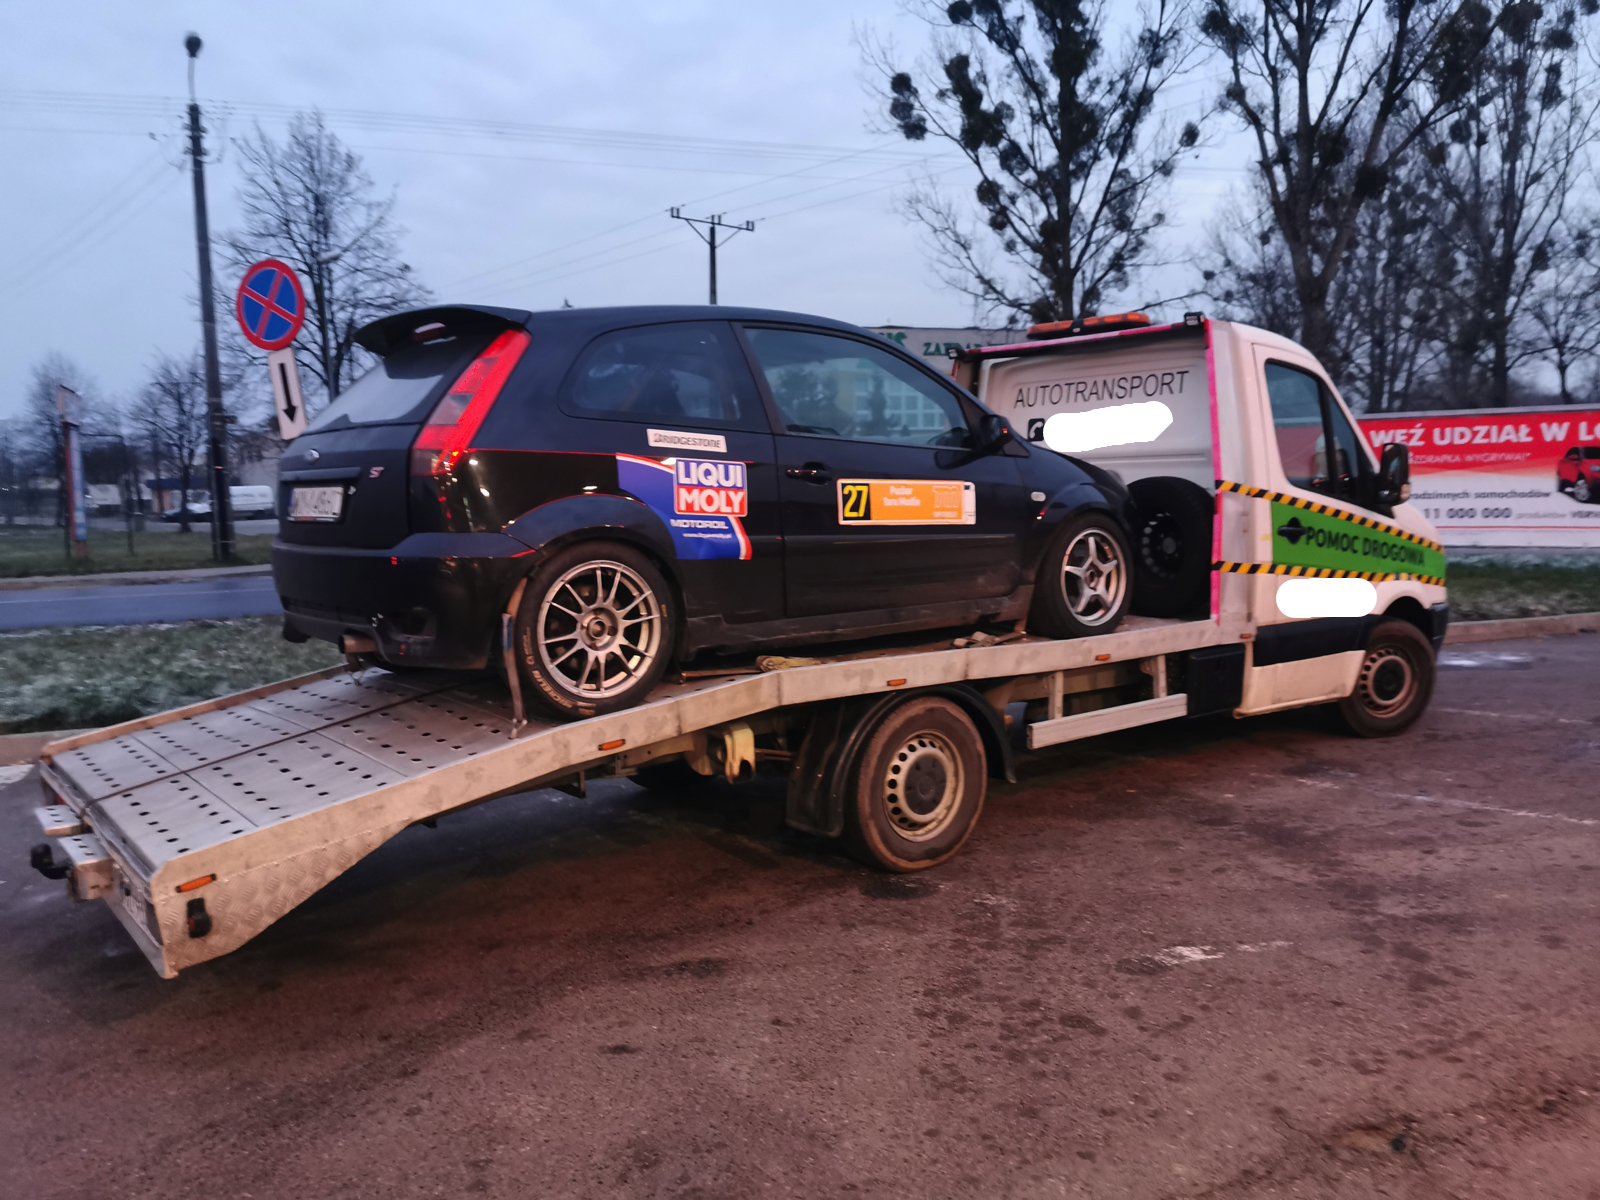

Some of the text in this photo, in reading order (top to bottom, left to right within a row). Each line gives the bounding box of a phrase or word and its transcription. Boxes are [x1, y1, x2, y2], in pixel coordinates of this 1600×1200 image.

[1013, 370, 1190, 409] AUTOTRANSPORT
[1369, 422, 1426, 448] WEŹ
[1432, 424, 1533, 446] UDZIAŁ
[1540, 421, 1570, 442] W
[677, 461, 743, 488] LIQUI
[679, 487, 745, 513] MOLY
[842, 485, 869, 518] 27
[1305, 525, 1360, 554] POMOC
